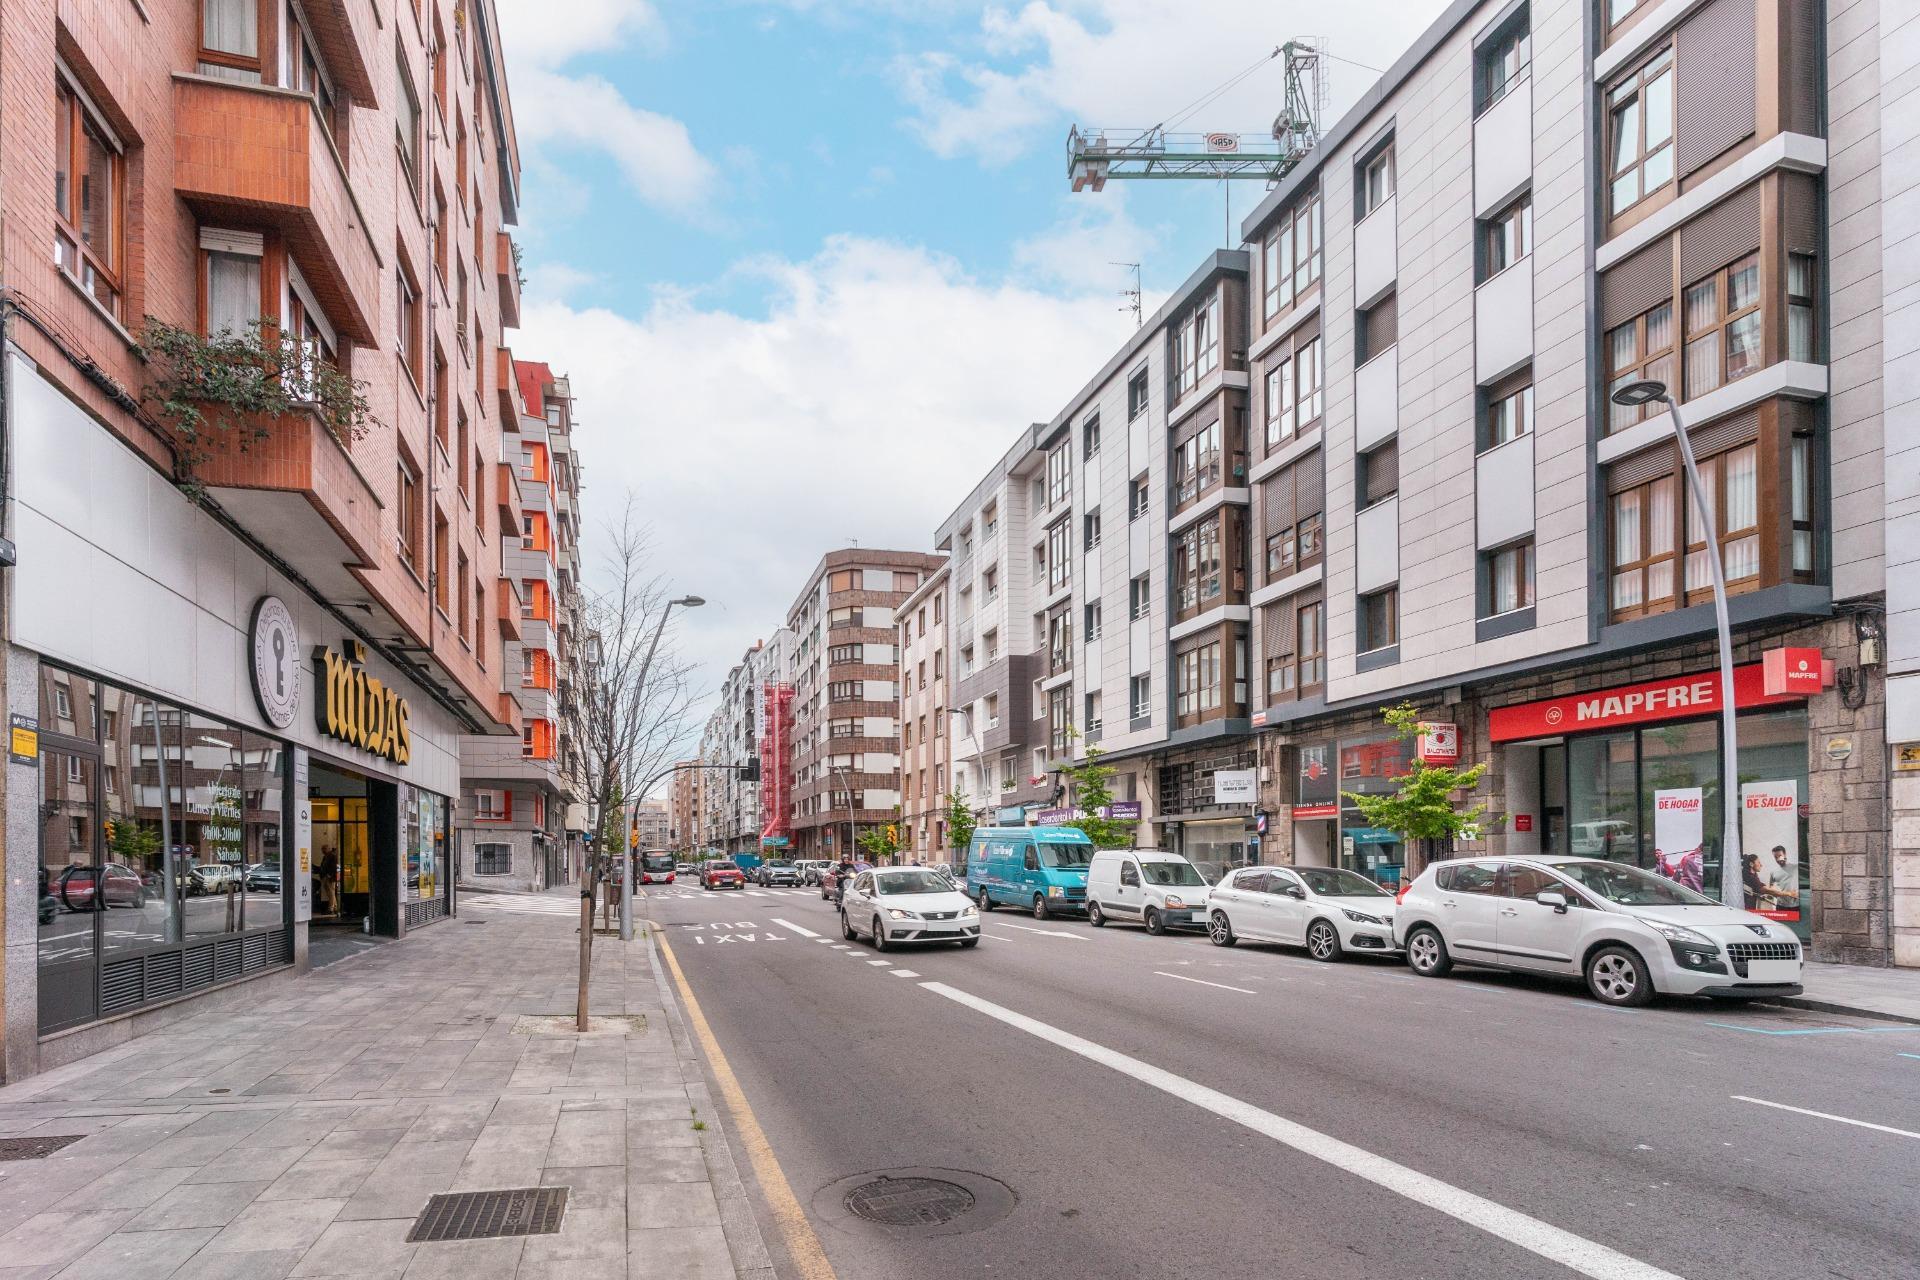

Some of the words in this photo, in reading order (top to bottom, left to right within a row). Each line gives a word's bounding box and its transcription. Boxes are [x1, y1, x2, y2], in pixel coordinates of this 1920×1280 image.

[1789, 671, 1818, 679] MAPFRE
[1577, 681, 1712, 721] MAPFRE
[1659, 801, 1669, 809] DE
[1671, 799, 1699, 809] HOGAR
[1747, 799, 1759, 808] DE
[1761, 797, 1793, 808] SALUD
[187, 802, 209, 815] Lunes
[217, 804, 241, 819] Viernes
[216, 847, 241, 861] Sábado
[681, 921, 758, 931] BUS
[695, 933, 788, 945] TAXI
